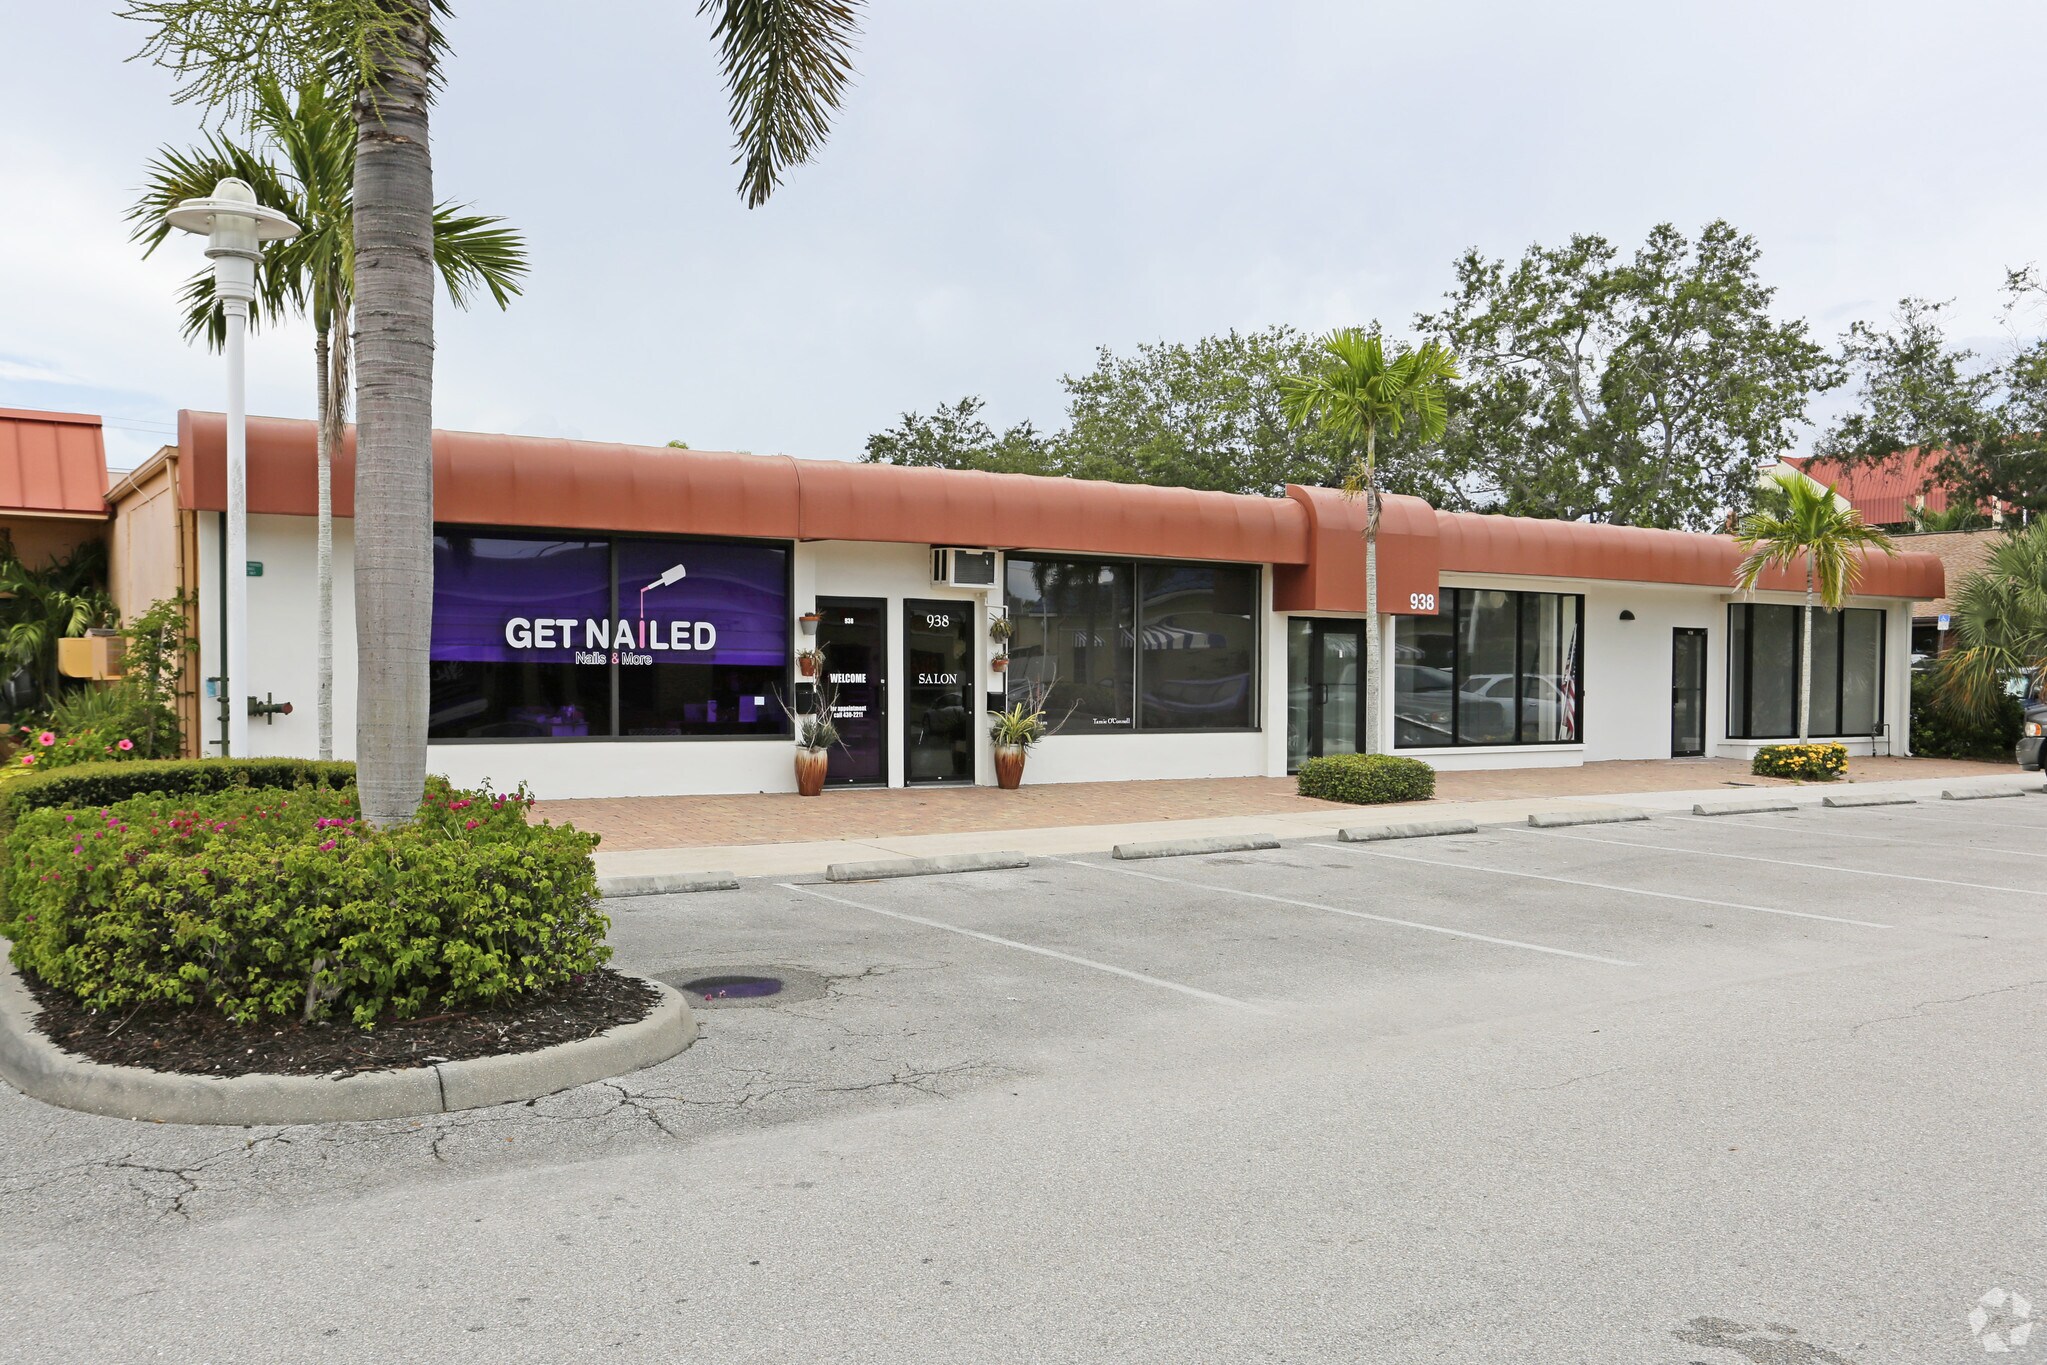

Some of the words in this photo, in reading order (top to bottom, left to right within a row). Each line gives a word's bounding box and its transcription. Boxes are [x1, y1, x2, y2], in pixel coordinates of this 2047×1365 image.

[1410, 593, 1435, 610] 938
[926, 614, 950, 628] 938
[505, 617, 578, 649] GET
[586, 618, 717, 650] NAILED
[575, 651, 607, 665] Nails
[611, 652, 619, 664] &
[621, 651, 653, 666] More
[830, 673, 867, 684] WELCOME
[918, 673, 958, 684] SALON
